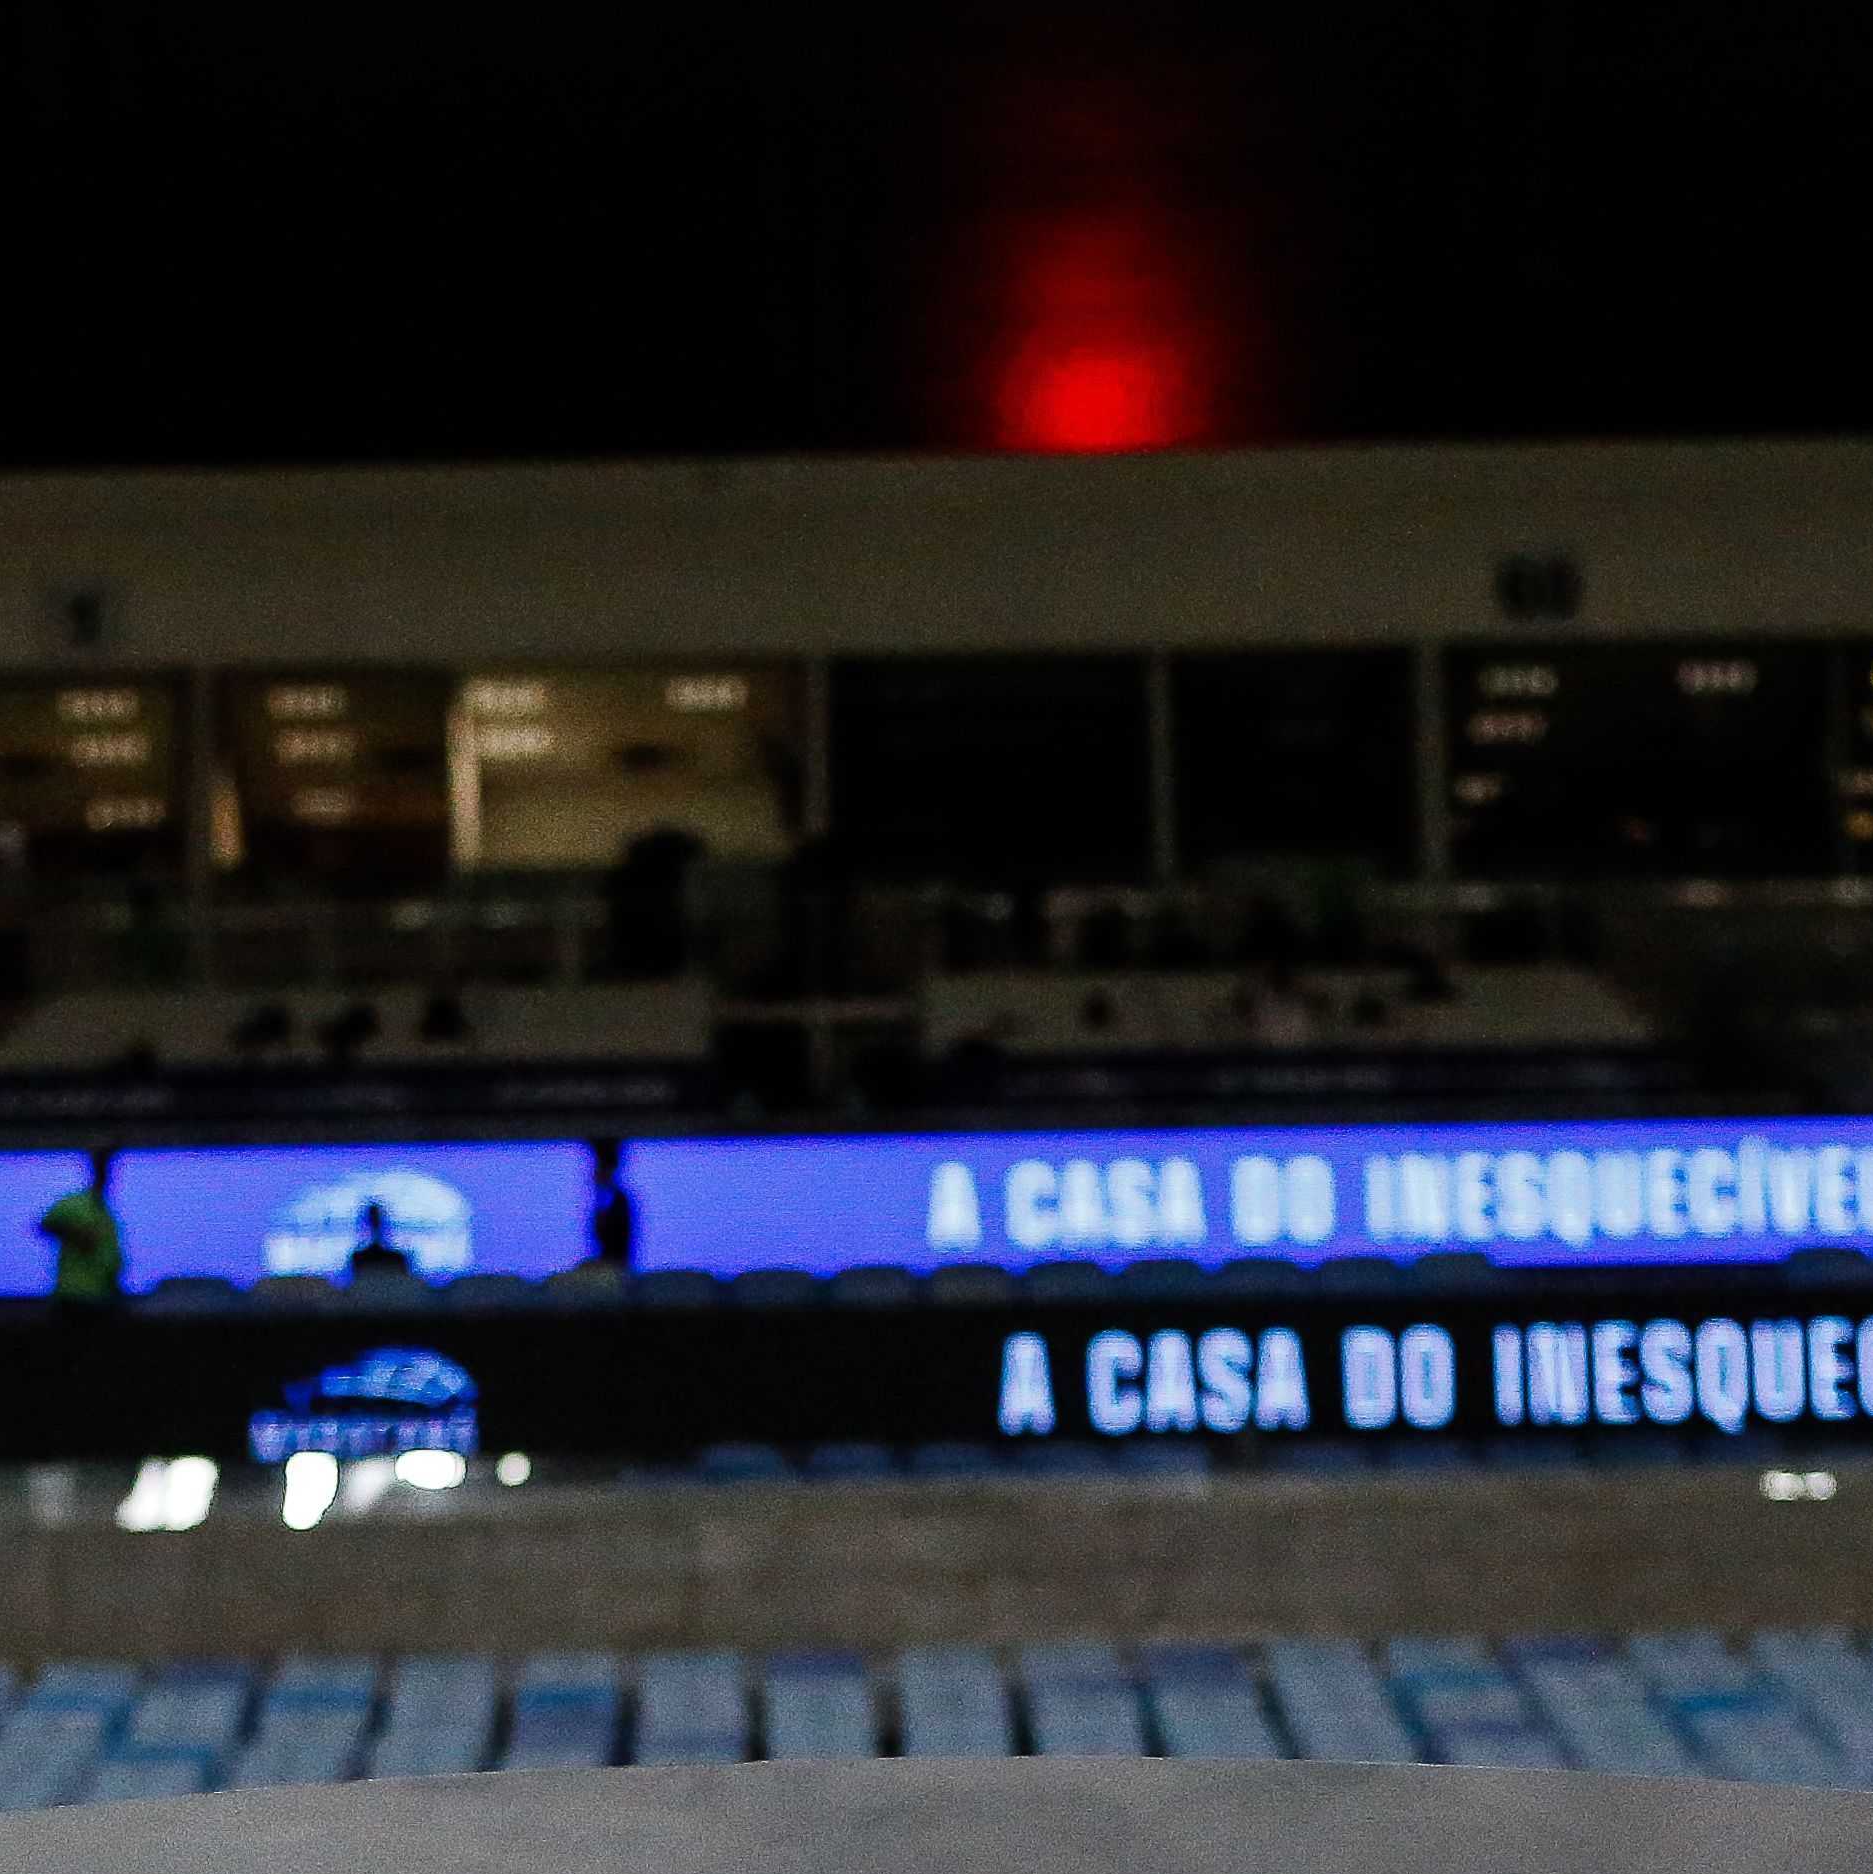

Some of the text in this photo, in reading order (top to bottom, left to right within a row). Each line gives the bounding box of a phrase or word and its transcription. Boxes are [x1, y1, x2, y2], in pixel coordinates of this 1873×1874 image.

[926, 1160, 982, 1249] A
[1003, 1156, 1207, 1249] CASA
[1229, 1152, 1338, 1246] DO
[997, 1331, 1057, 1435] A
[1085, 1326, 1311, 1434] CASA
[1340, 1322, 1457, 1430] DO
